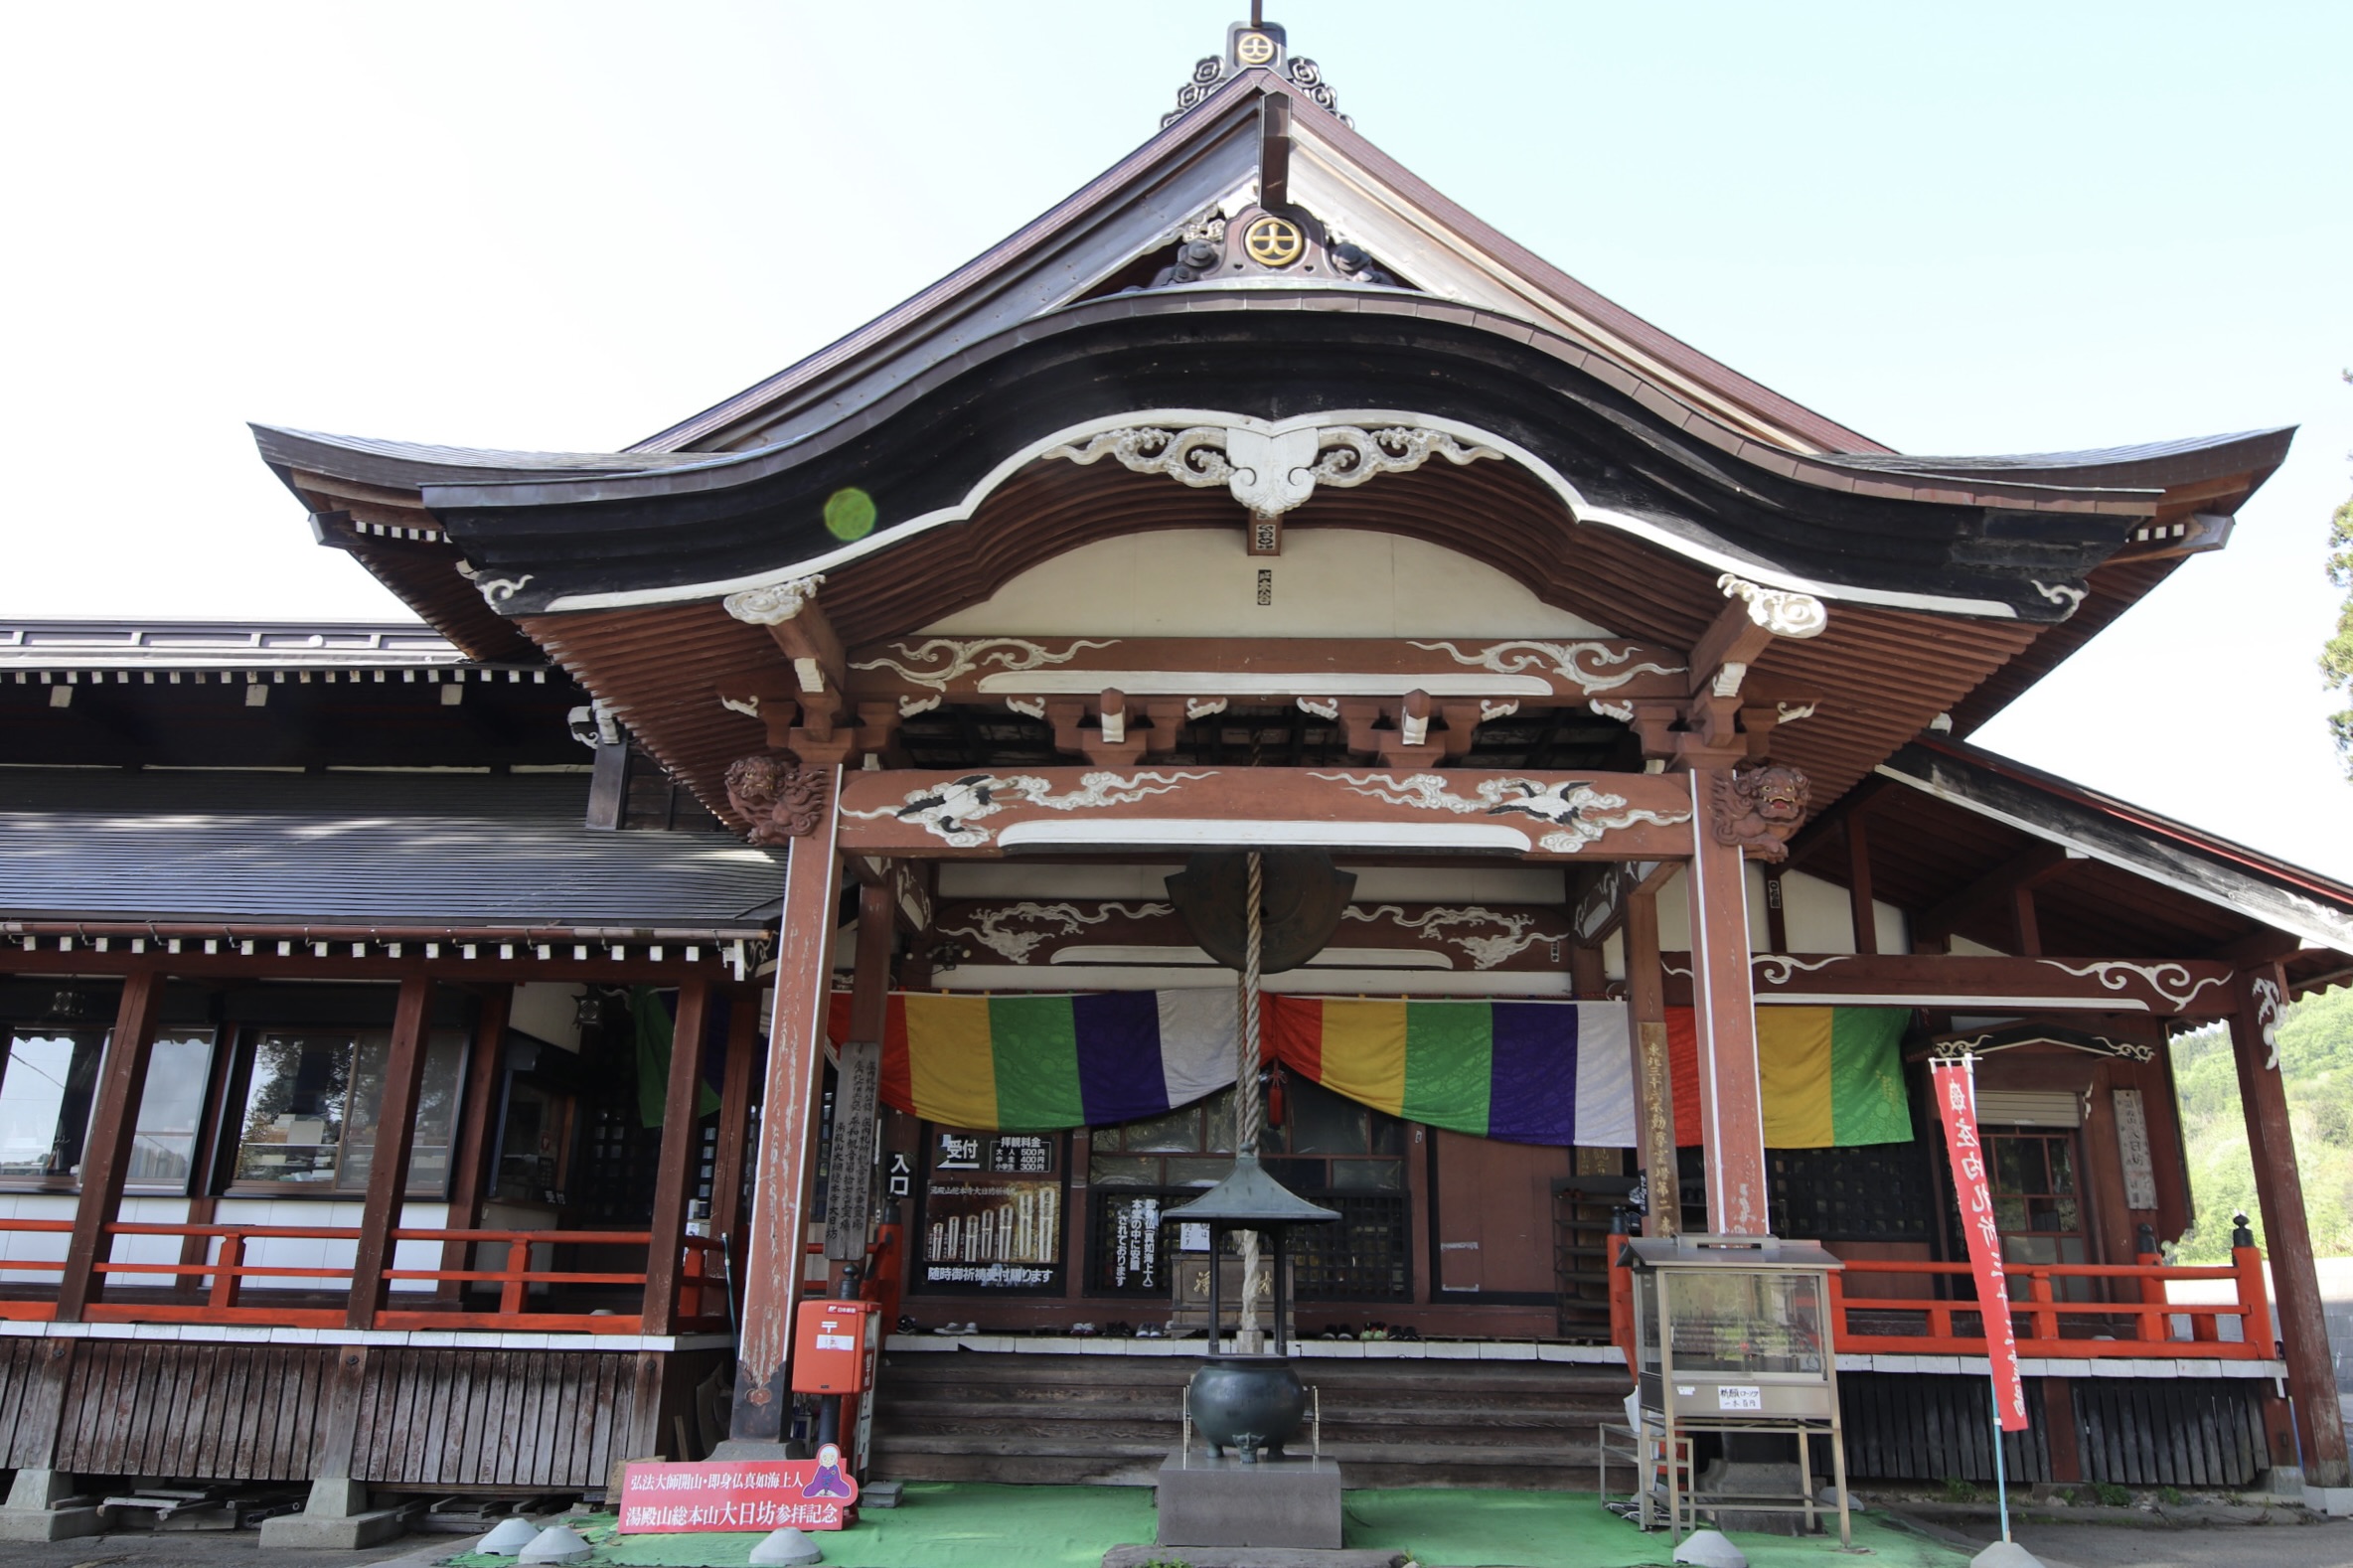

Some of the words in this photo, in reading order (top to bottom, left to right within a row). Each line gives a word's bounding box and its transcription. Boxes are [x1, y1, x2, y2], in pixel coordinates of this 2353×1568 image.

[946, 1140, 979, 1160] 受付
[1001, 1137, 1041, 1148] 拝観料金
[889, 1154, 910, 1195] 入口
[626, 1501, 838, 1527] 湯殿山総本山大日坊参拝記念
